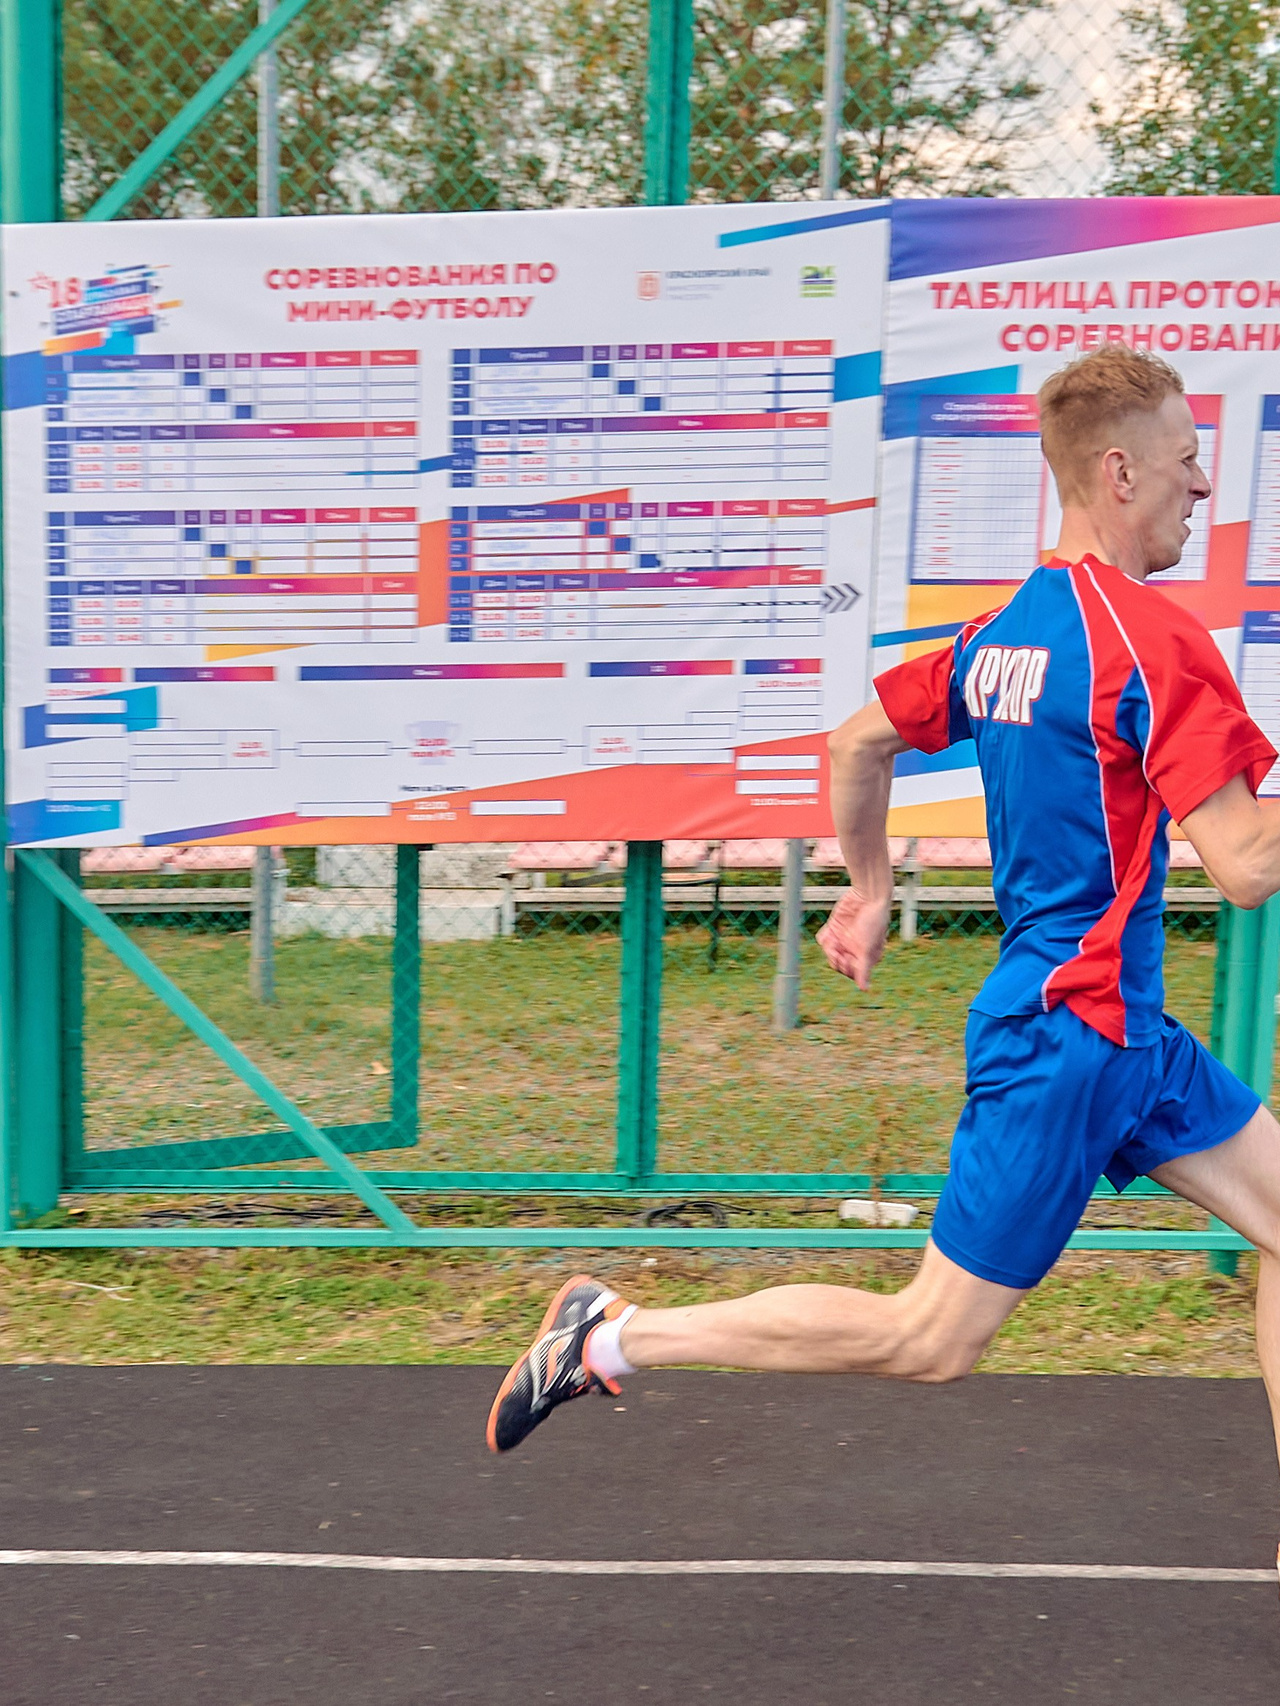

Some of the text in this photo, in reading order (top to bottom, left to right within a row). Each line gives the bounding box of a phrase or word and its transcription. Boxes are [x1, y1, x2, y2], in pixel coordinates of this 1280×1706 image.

[264, 262, 558, 290] СОРЕВНОВАНИЯ ПО
[287, 297, 535, 322] МИНИ-ФУТБОЛУ
[928, 281, 1117, 314] ТАБЛИЦА
